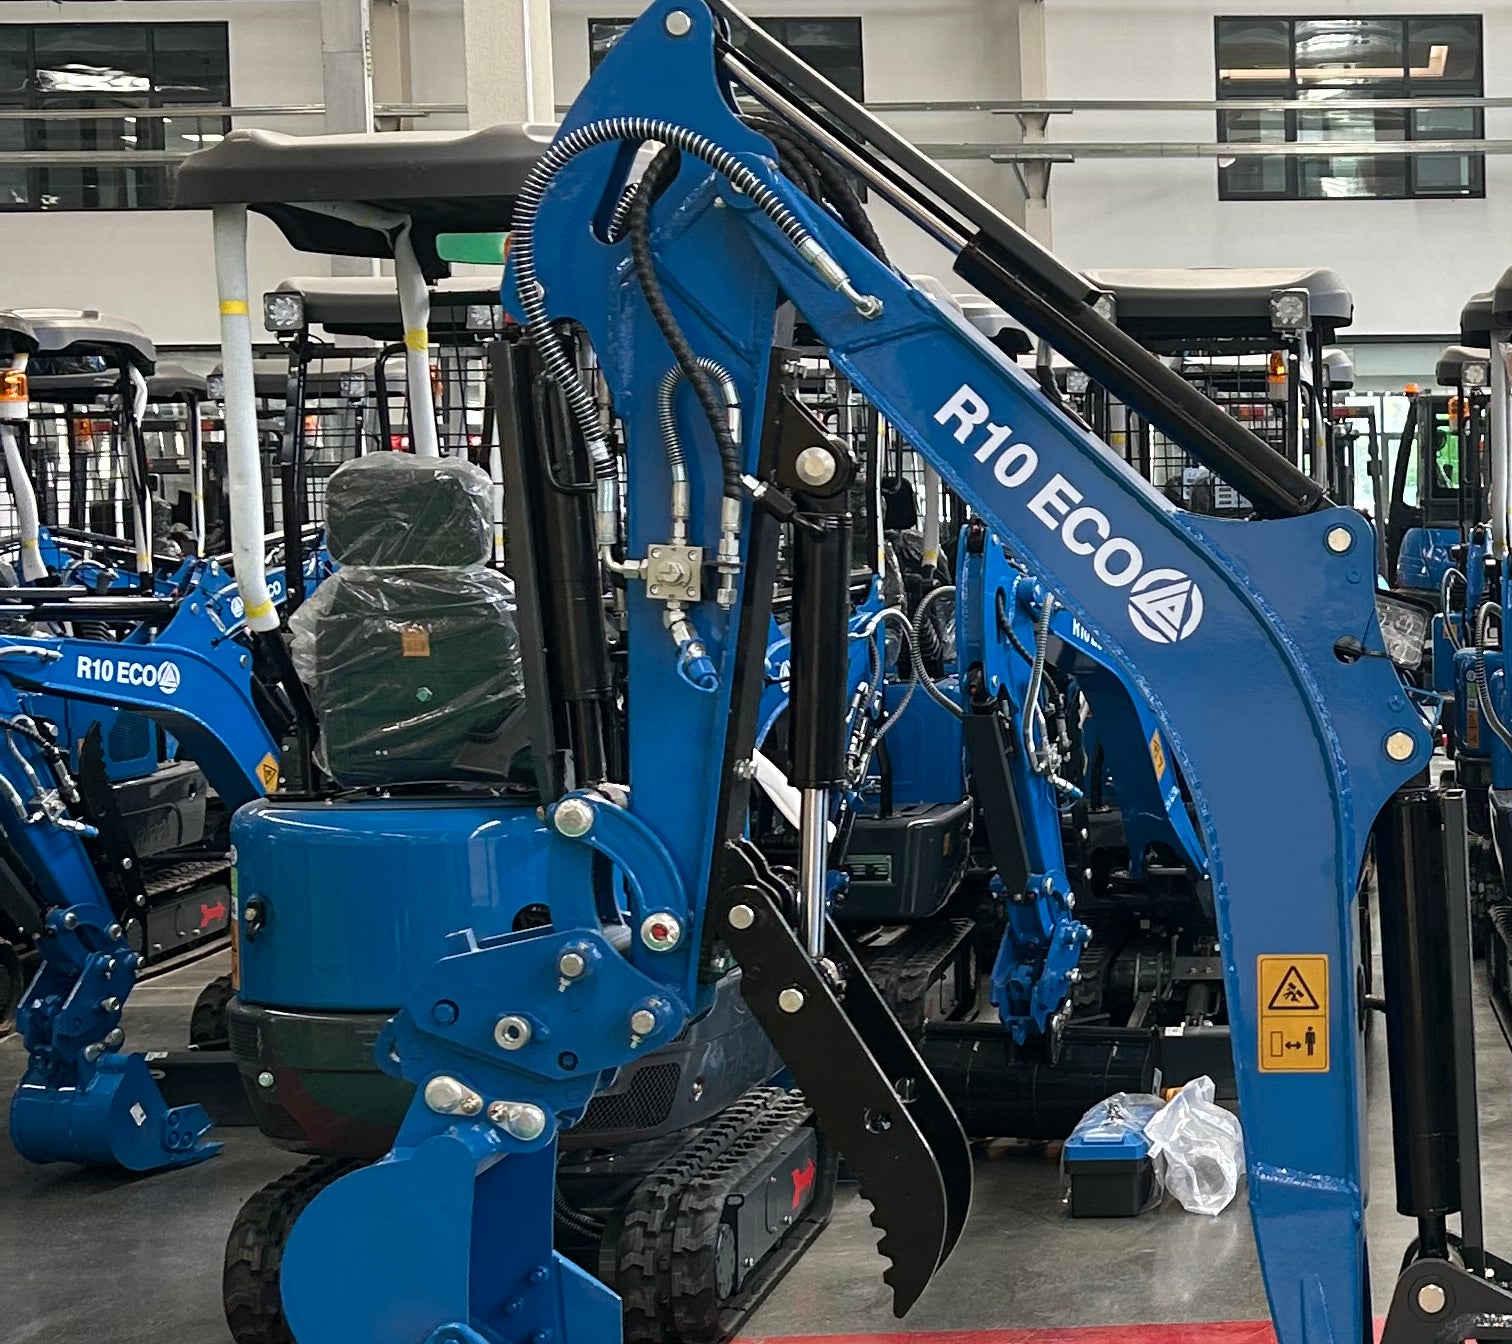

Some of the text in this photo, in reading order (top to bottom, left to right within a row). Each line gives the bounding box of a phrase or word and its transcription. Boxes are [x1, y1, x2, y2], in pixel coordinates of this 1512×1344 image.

[933, 384, 1143, 587] R10 ECO
[77, 655, 157, 687] R10 ECO
